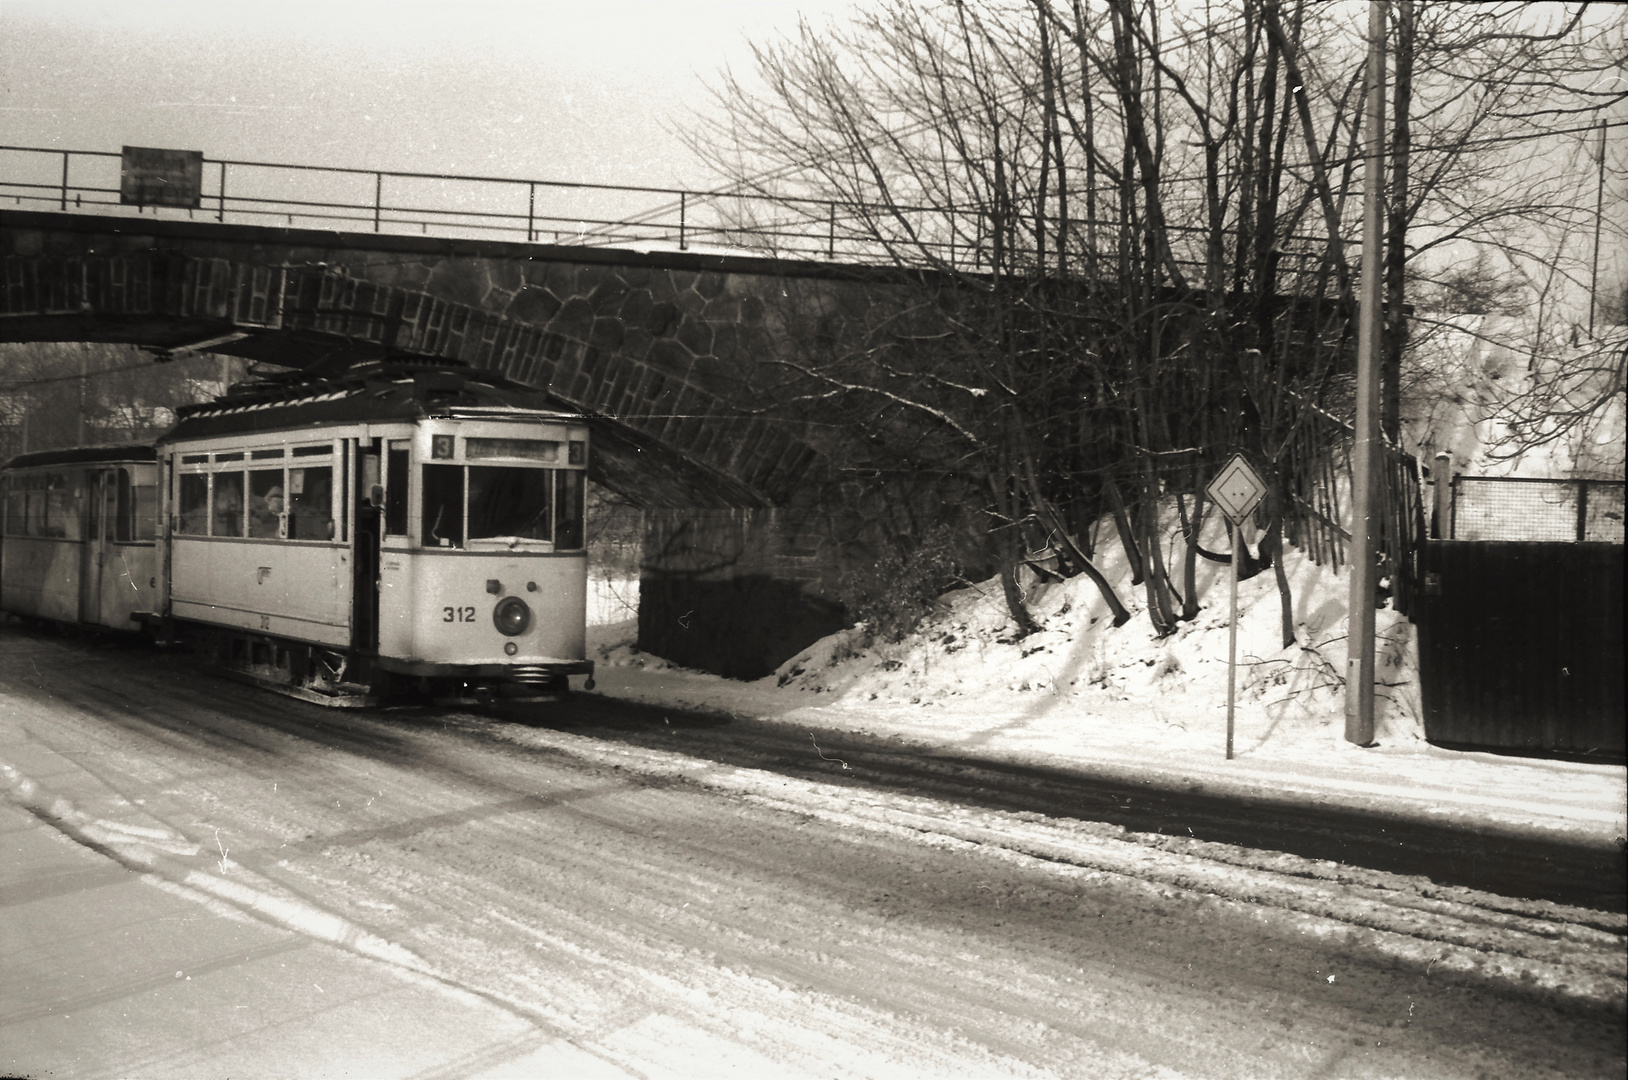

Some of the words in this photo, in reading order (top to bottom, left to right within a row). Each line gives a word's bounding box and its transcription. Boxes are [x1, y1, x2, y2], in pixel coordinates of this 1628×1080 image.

[437, 437, 450, 456] 3
[572, 443, 581, 462] 3
[443, 607, 475, 622] 312
